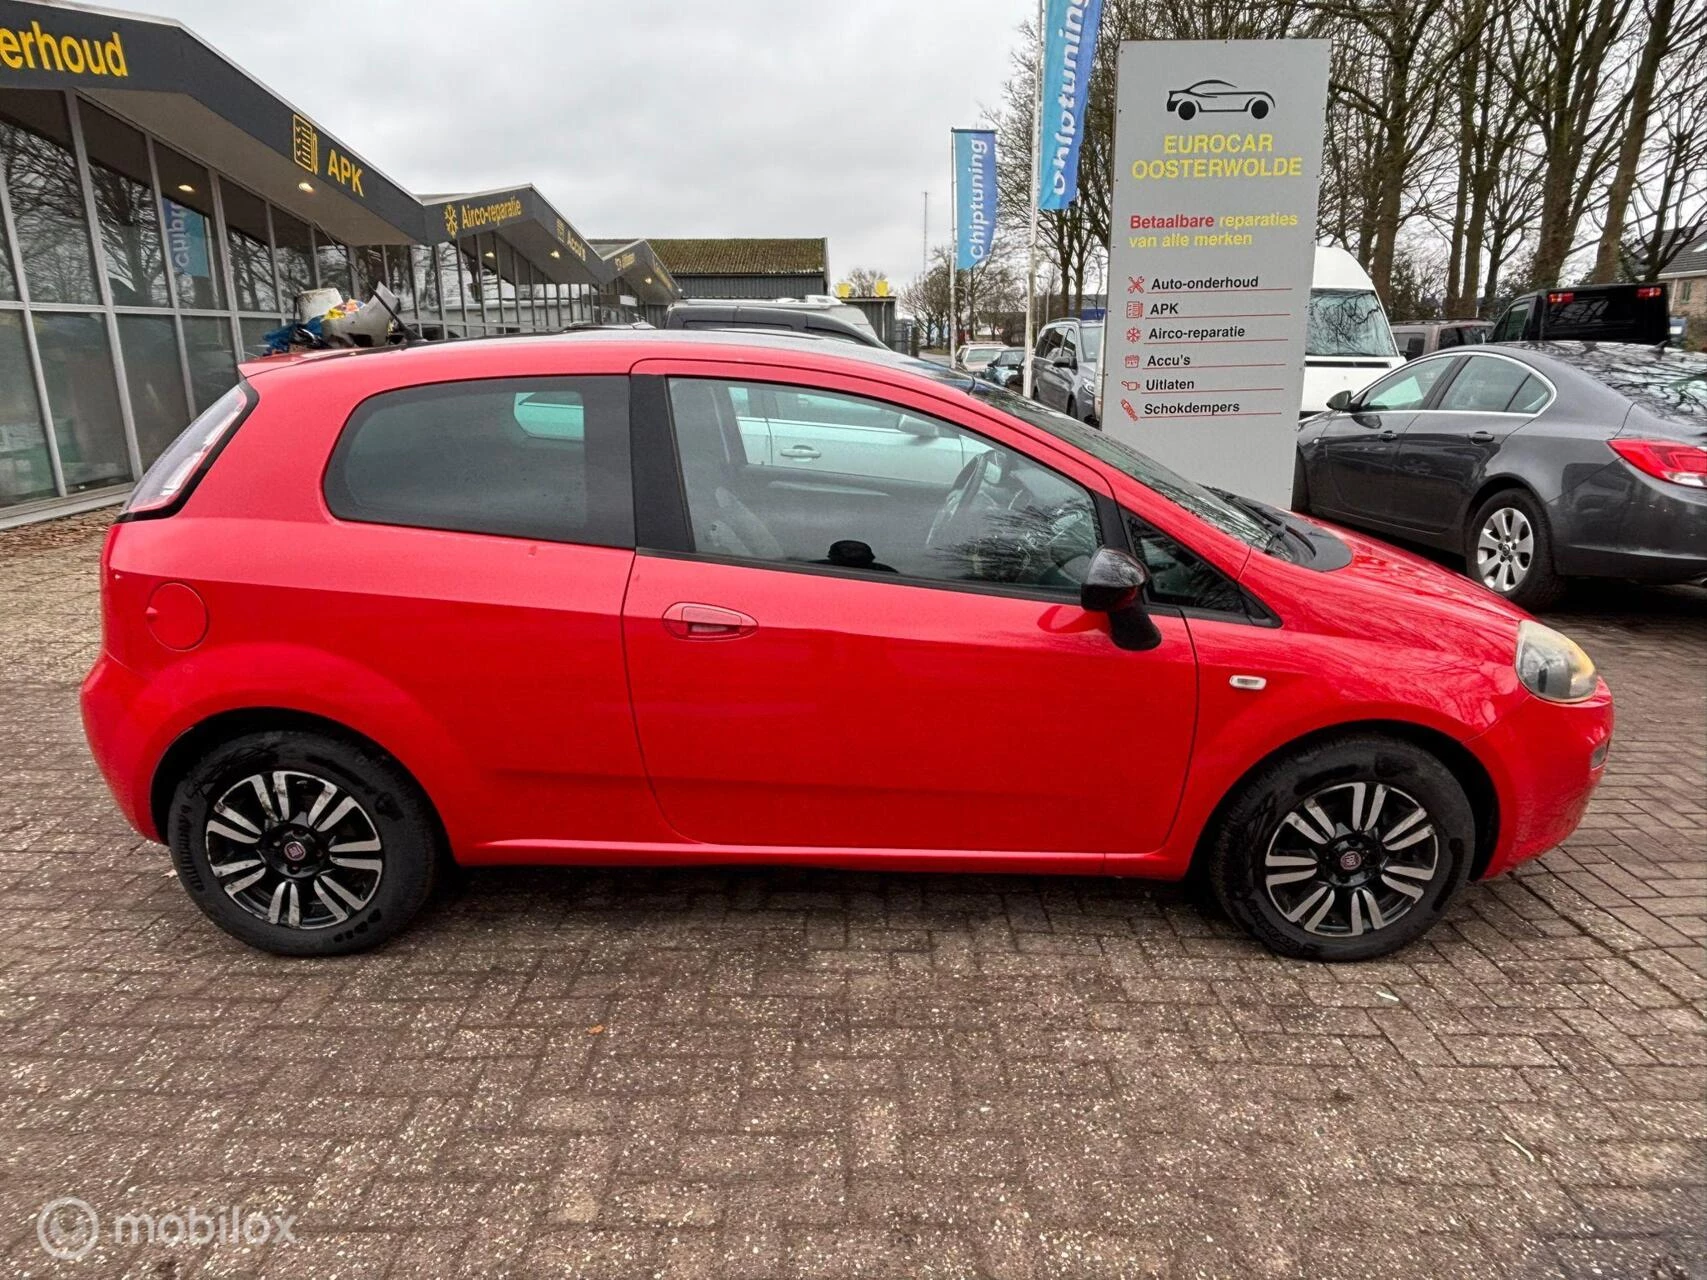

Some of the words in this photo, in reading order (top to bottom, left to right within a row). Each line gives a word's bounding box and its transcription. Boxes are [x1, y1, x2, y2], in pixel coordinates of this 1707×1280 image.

[0, 21, 128, 77] erhoud
[1053, 0, 1090, 196] Chiptunin
[1163, 133, 1274, 154] EUROCAR
[328, 148, 364, 198] APK
[1131, 157, 1303, 179] OOSTERWOLDE
[969, 139, 989, 260] Chiptuning
[462, 195, 521, 229] Airco-reparatie
[1130, 214, 1215, 229] Betaalbare
[1218, 212, 1299, 230] reparaties
[1128, 235, 1157, 248] van
[1162, 233, 1190, 248] alle
[1194, 232, 1253, 247] merken
[1151, 276, 1259, 290] Auto-onderhoud
[1150, 303, 1179, 315] APK
[1149, 325, 1246, 341] Airco-reparatie
[1147, 354, 1191, 367] Accu's
[1146, 379, 1195, 391] Uitlaten
[1144, 402, 1240, 416] Schokdempers
